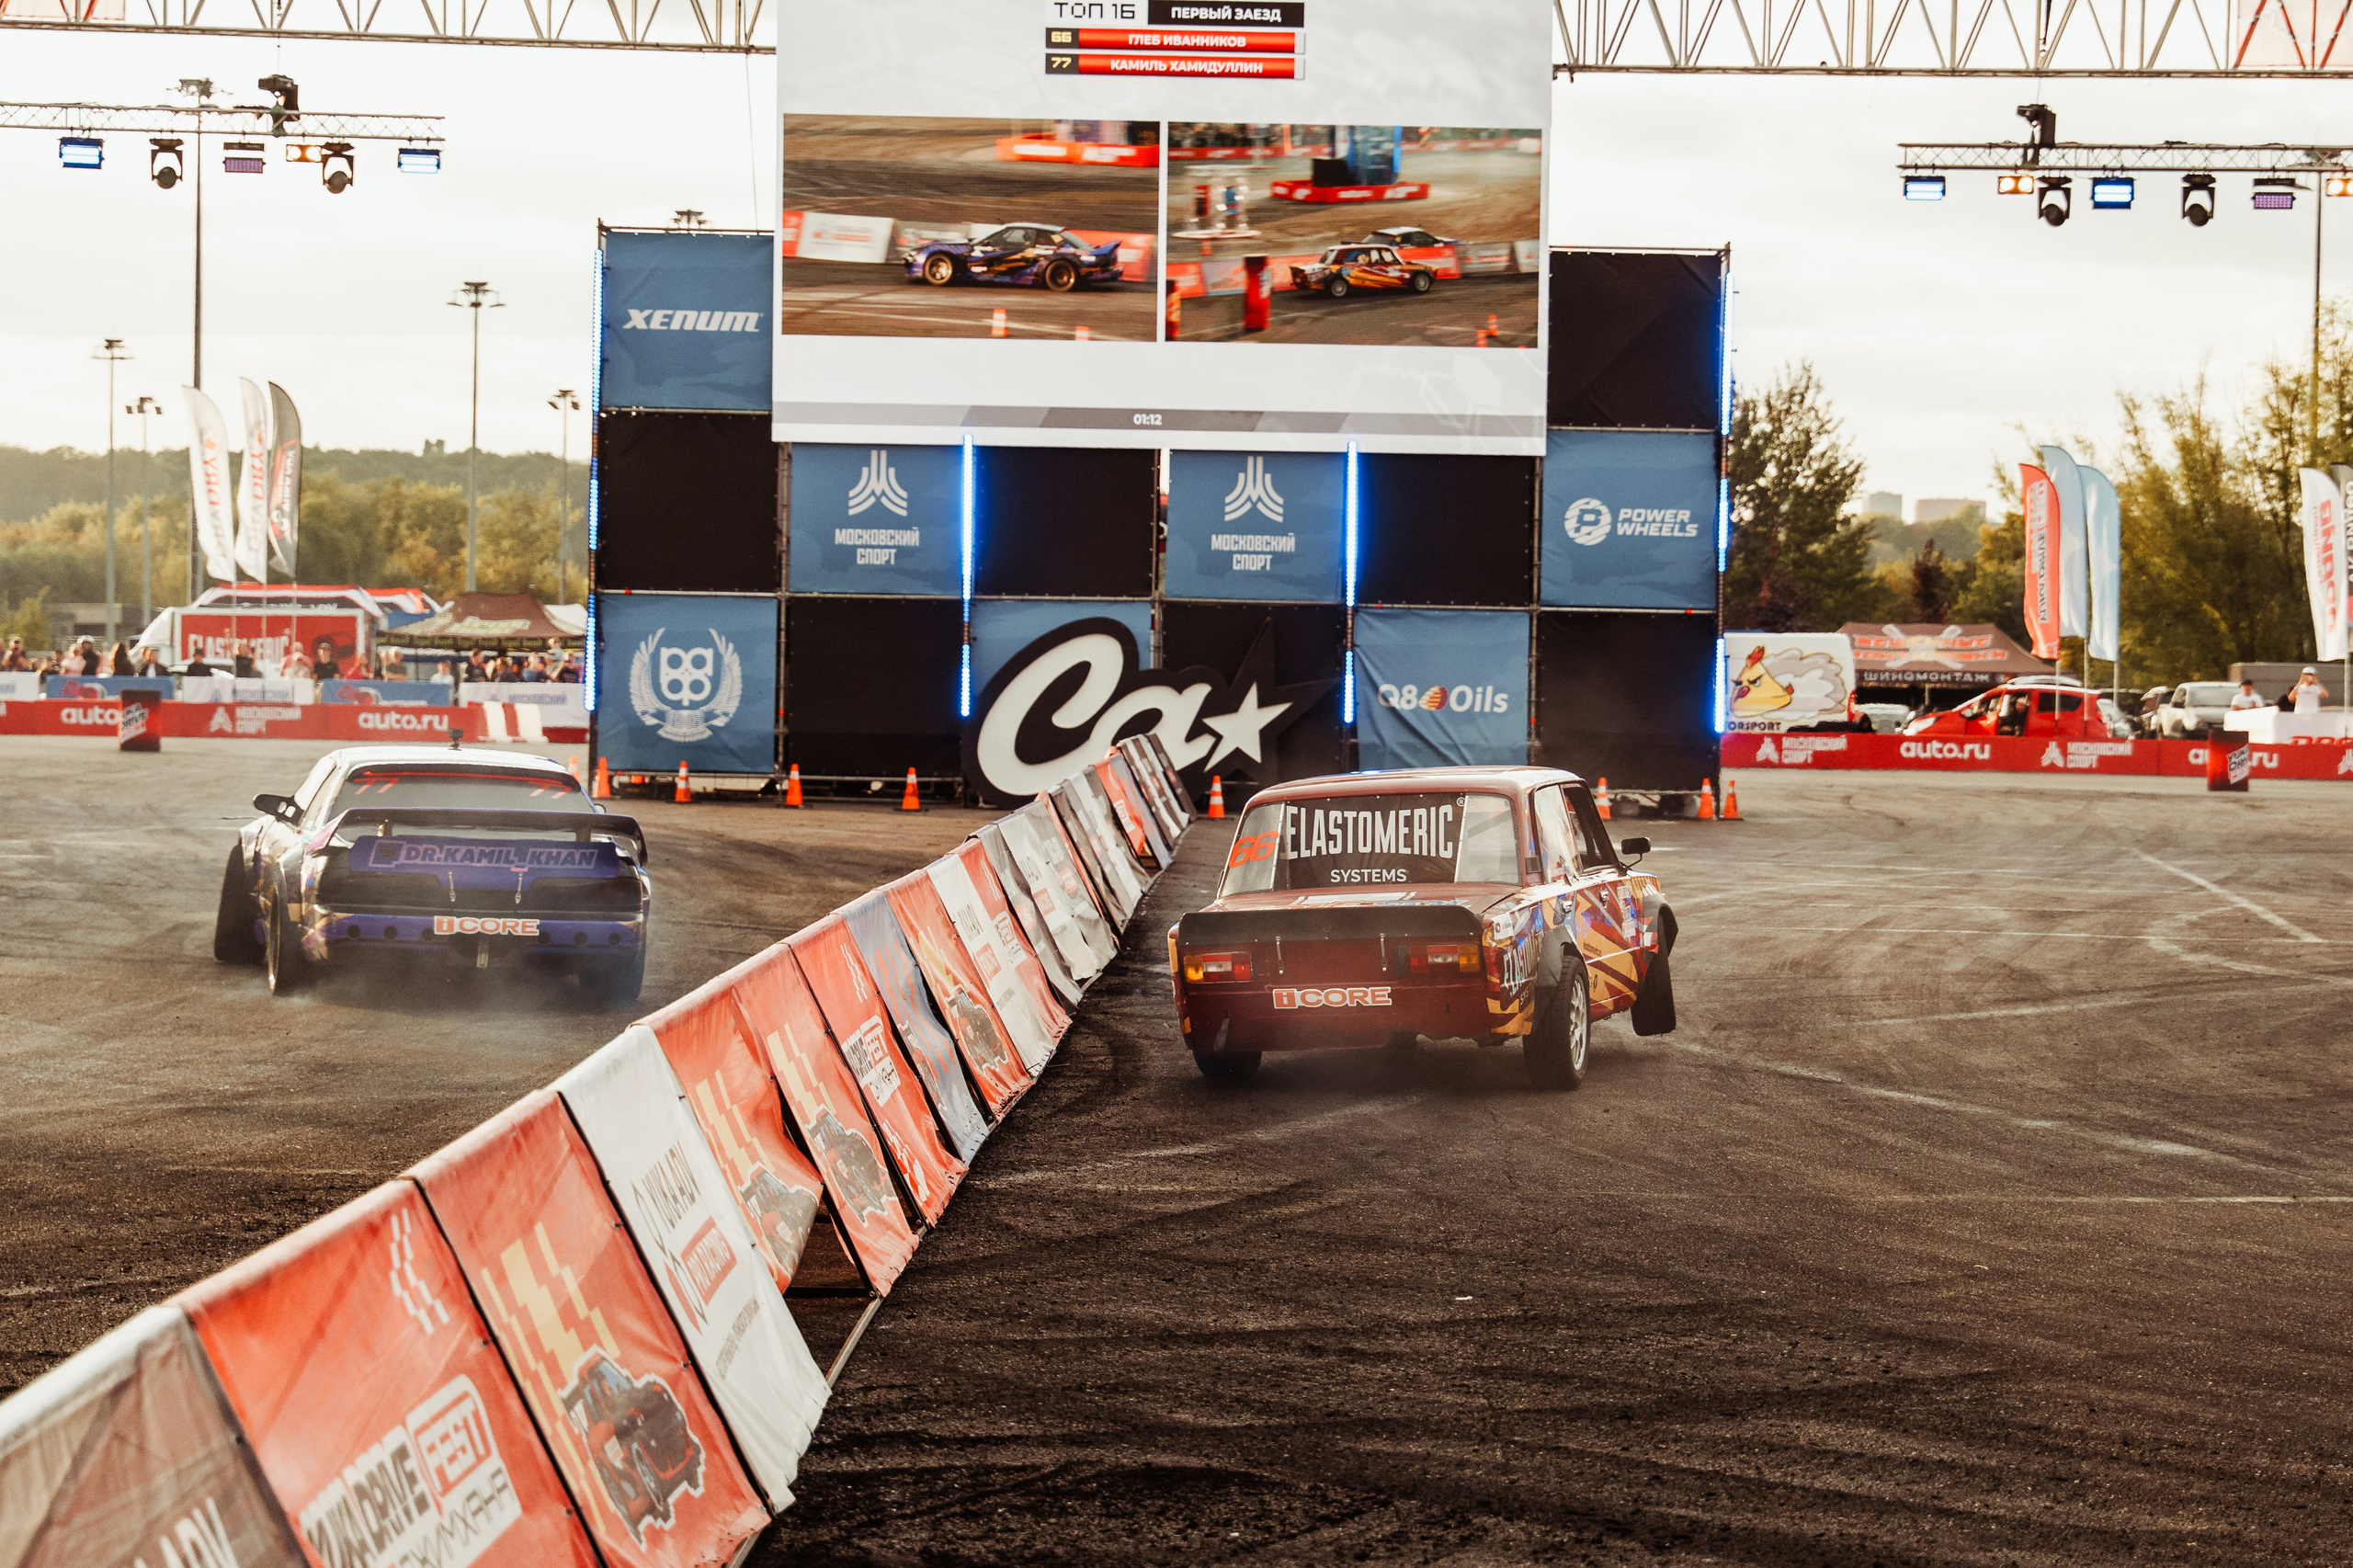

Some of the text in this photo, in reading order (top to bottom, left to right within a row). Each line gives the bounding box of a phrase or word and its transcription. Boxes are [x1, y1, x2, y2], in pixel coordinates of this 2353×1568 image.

[1054, 2, 1136, 19] ТОП 16
[1171, 6, 1281, 22] ПЕРВЫЙ ЗАЕЗД
[1051, 30, 1072, 43] 66
[1128, 33, 1246, 48] ГЛЕБ ИВАННИКОВ
[1051, 57, 1072, 69] 77
[1110, 59, 1263, 75] КАМИЛЬ ХАМИДУЛЛИН
[622, 308, 761, 333] XENUM
[1133, 413, 1163, 426] 01:12
[1618, 508, 1691, 523] POWER
[835, 527, 920, 547] МОСКОВСКИЙ
[1616, 522, 1699, 537] WHEELS
[1211, 532, 1295, 553] МОСКОВСКИЙ
[856, 549, 897, 565] СПОРТ
[1232, 554, 1273, 571] СПОРТ
[1863, 672, 1990, 683] ШИНОМОНТАЖ
[1449, 685, 1509, 714] Oils
[358, 711, 449, 730] auto.ru
[1728, 722, 1781, 731] ORSPORT
[1900, 740, 1991, 759] auto.ru
[2067, 741, 2132, 756] МОСКОВСКИЙ
[1781, 750, 1813, 764] СПОРТ
[2066, 755, 2099, 768] СПОРТ
[1229, 830, 1279, 869] 66
[528, 847, 597, 869] KHAN
[1330, 869, 1407, 883] SYSTEMS
[351, 1441, 431, 1555] DRIVE
[416, 1398, 488, 1493] FEST
